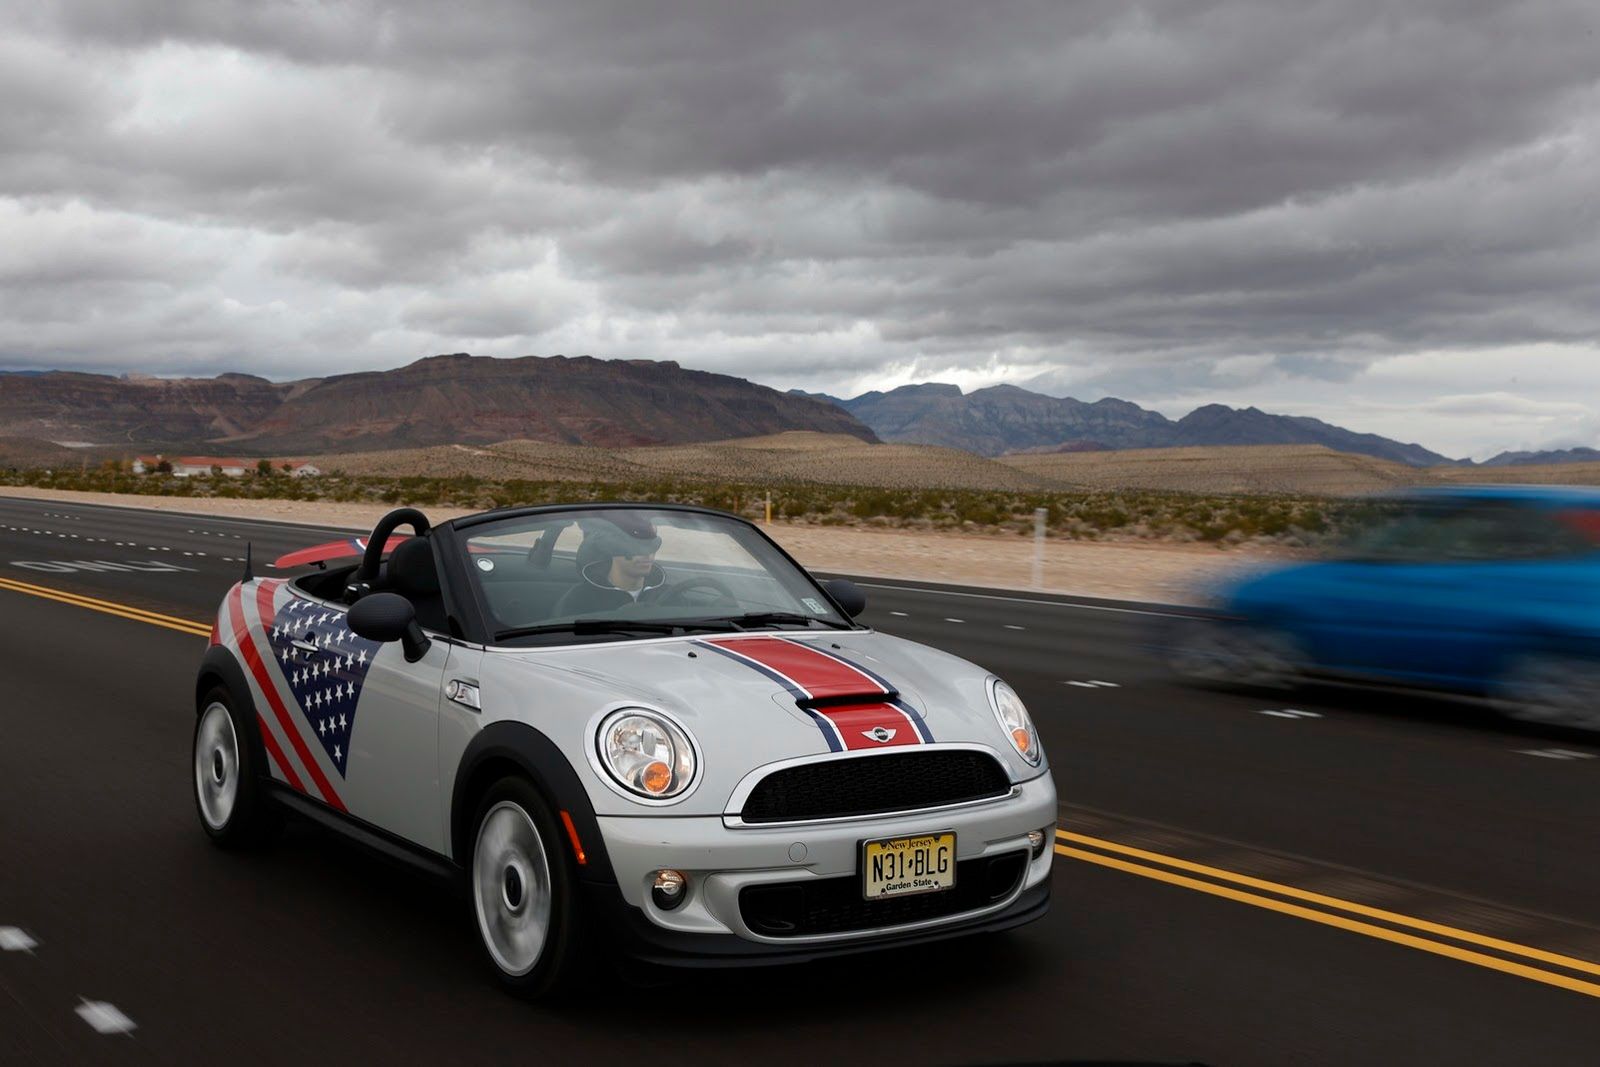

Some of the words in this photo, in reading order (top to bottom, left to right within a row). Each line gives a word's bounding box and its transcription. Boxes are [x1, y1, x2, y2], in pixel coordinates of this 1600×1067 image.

[9, 560, 199, 573] ONLY
[887, 840, 906, 850] New
[907, 838, 933, 850] Jersey
[886, 881, 912, 891] Garden
[913, 878, 932, 887] State
